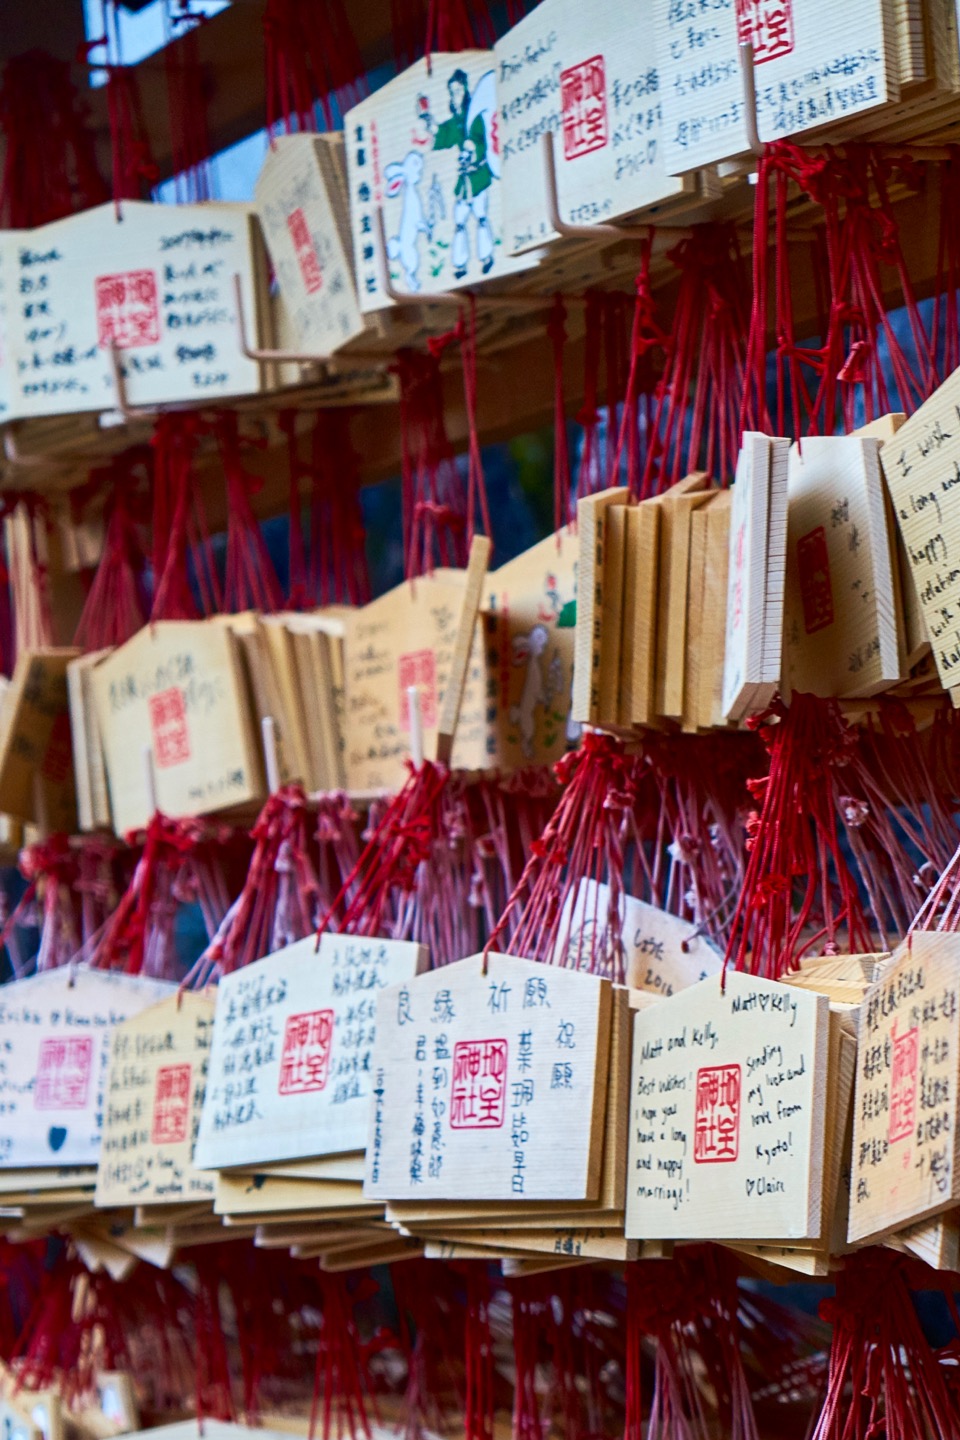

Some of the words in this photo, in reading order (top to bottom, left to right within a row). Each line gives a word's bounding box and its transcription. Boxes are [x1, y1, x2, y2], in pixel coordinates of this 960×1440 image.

[645, 967, 674, 998] 2016
[732, 992, 759, 1013] Matt
[771, 993, 798, 1027] Kelly
[667, 1026, 687, 1052] and
[636, 1156, 652, 1172] and
[656, 1153, 684, 1181] happy
[756, 1177, 786, 1197] Claire
